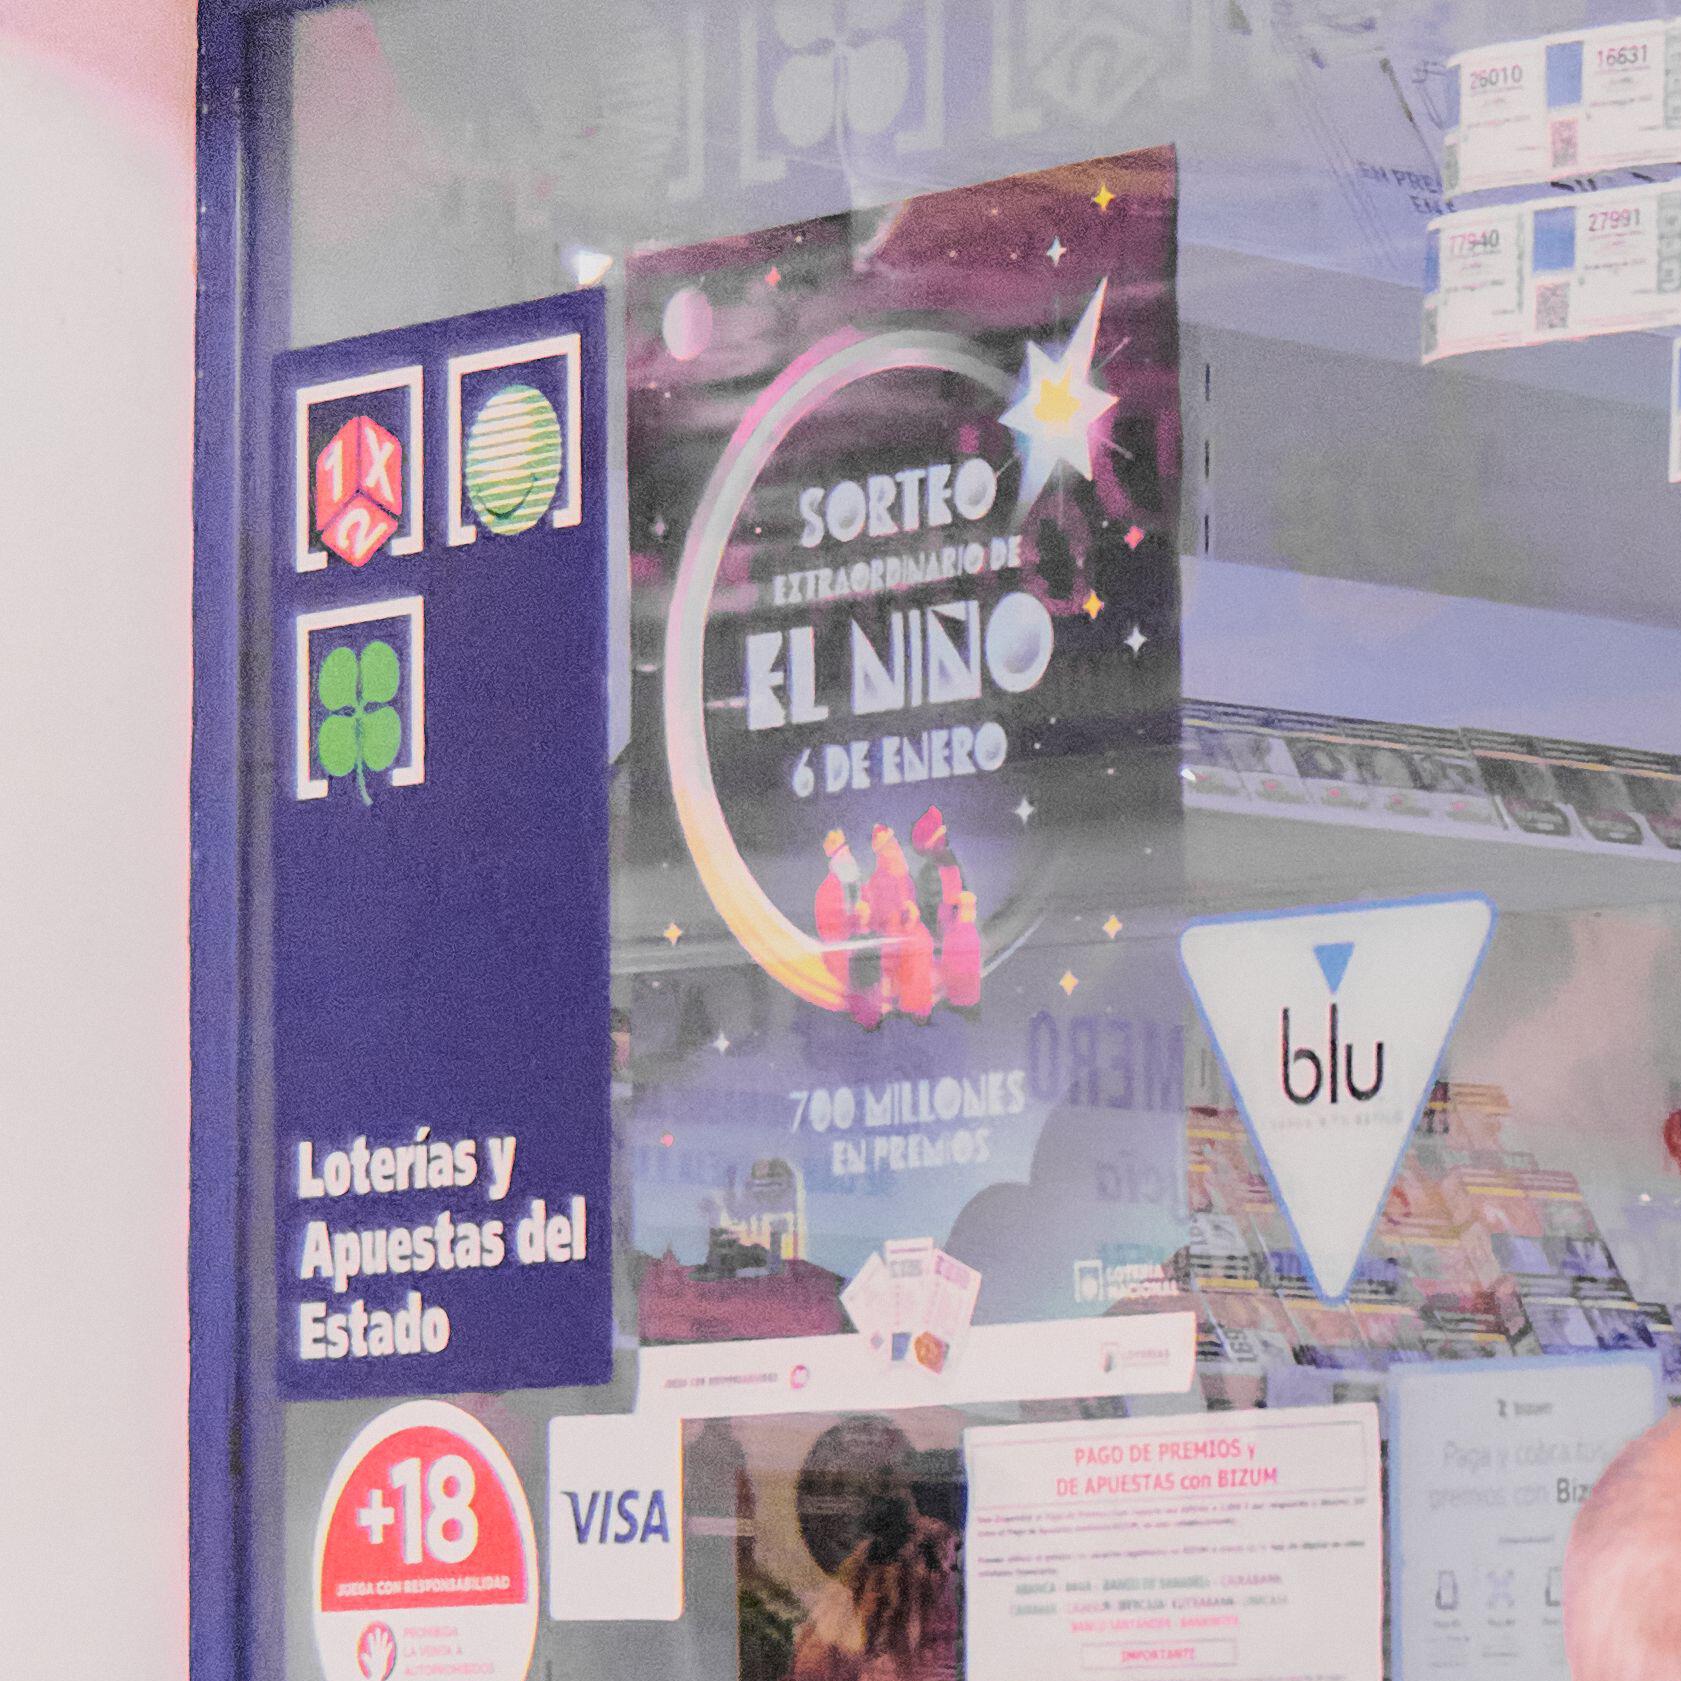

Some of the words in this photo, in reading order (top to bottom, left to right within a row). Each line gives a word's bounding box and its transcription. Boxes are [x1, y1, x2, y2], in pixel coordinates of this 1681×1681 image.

[800, 457, 997, 548] SORTEO
[772, 545, 984, 605] EXTRAORDINARIO
[990, 535, 1023, 571] DE
[746, 626, 829, 731] EL
[851, 592, 1054, 715] NIÑO
[793, 746, 815, 798] 6
[826, 741, 872, 793] DE
[882, 721, 1007, 785] ENERO
[1282, 1002, 1384, 1105] blu
[788, 1086, 856, 1133] 700
[863, 1071, 1026, 1131] MILLONES
[298, 1126, 478, 1199] Loterías
[488, 1135, 517, 1200] y
[832, 1140, 867, 1175] EN
[873, 1128, 991, 1172] PREMIOS
[299, 1211, 506, 1293] Apuestas
[517, 1195, 587, 1264] del
[298, 1290, 451, 1360] Estado
[1056, 1478, 1078, 1497] DE
[1085, 1473, 1175, 1495] APUESTAS
[1180, 1472, 1211, 1491] con
[1218, 1467, 1278, 1487] BIZUM
[1074, 1444, 1123, 1465] PAGO
[1130, 1443, 1152, 1463] DE
[1159, 1438, 1241, 1462] PREMIOS
[1247, 1444, 1256, 1462] y
[356, 1454, 478, 1566] +18
[561, 1490, 670, 1544] VISA
